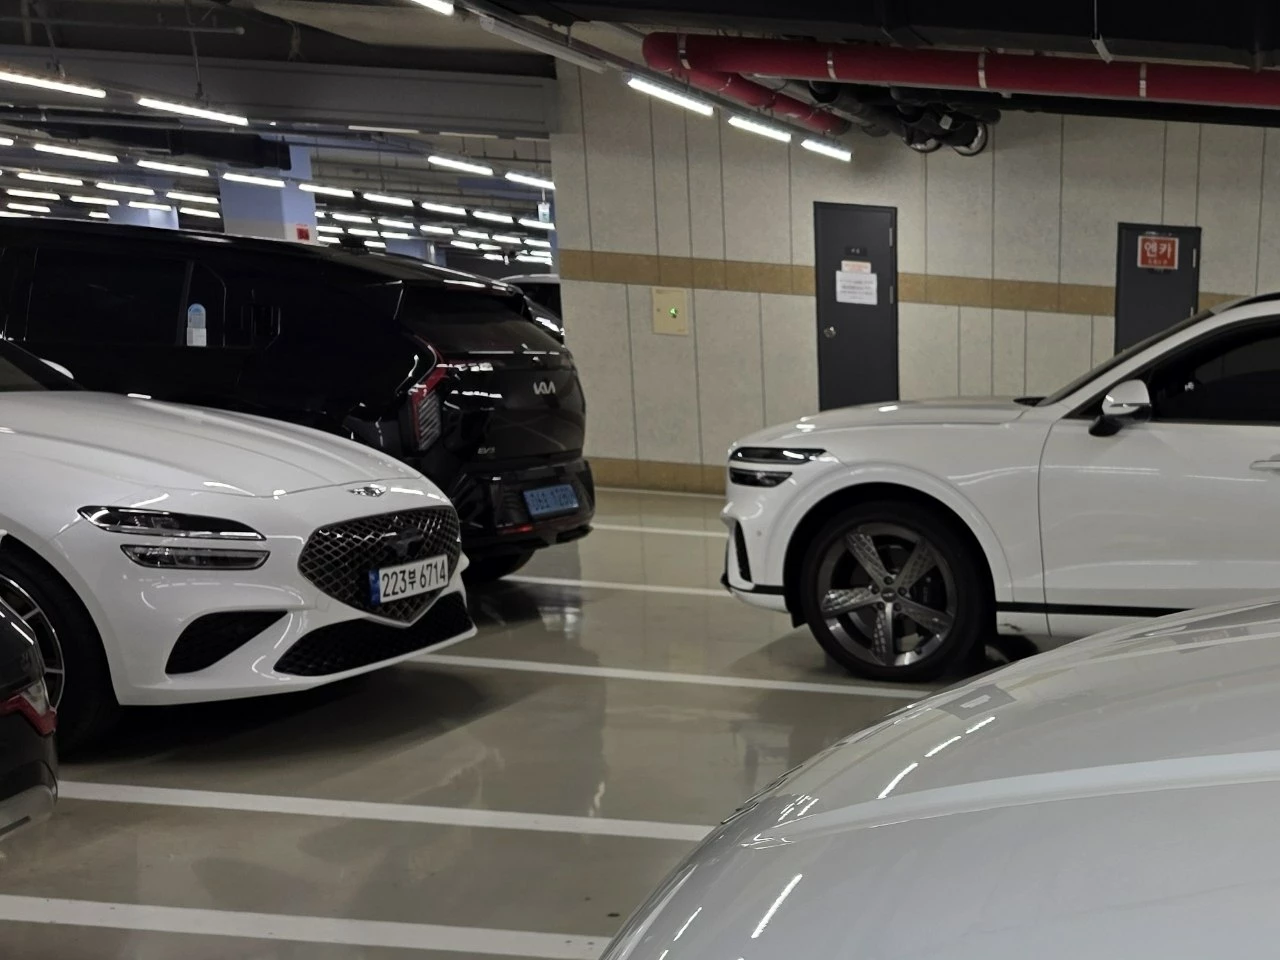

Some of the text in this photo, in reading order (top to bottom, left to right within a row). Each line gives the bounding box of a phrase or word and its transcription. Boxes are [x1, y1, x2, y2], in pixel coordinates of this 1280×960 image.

[1143, 241, 1172, 259] 엔카
[533, 380, 556, 395] KIA
[382, 559, 446, 598] 223부 6714
